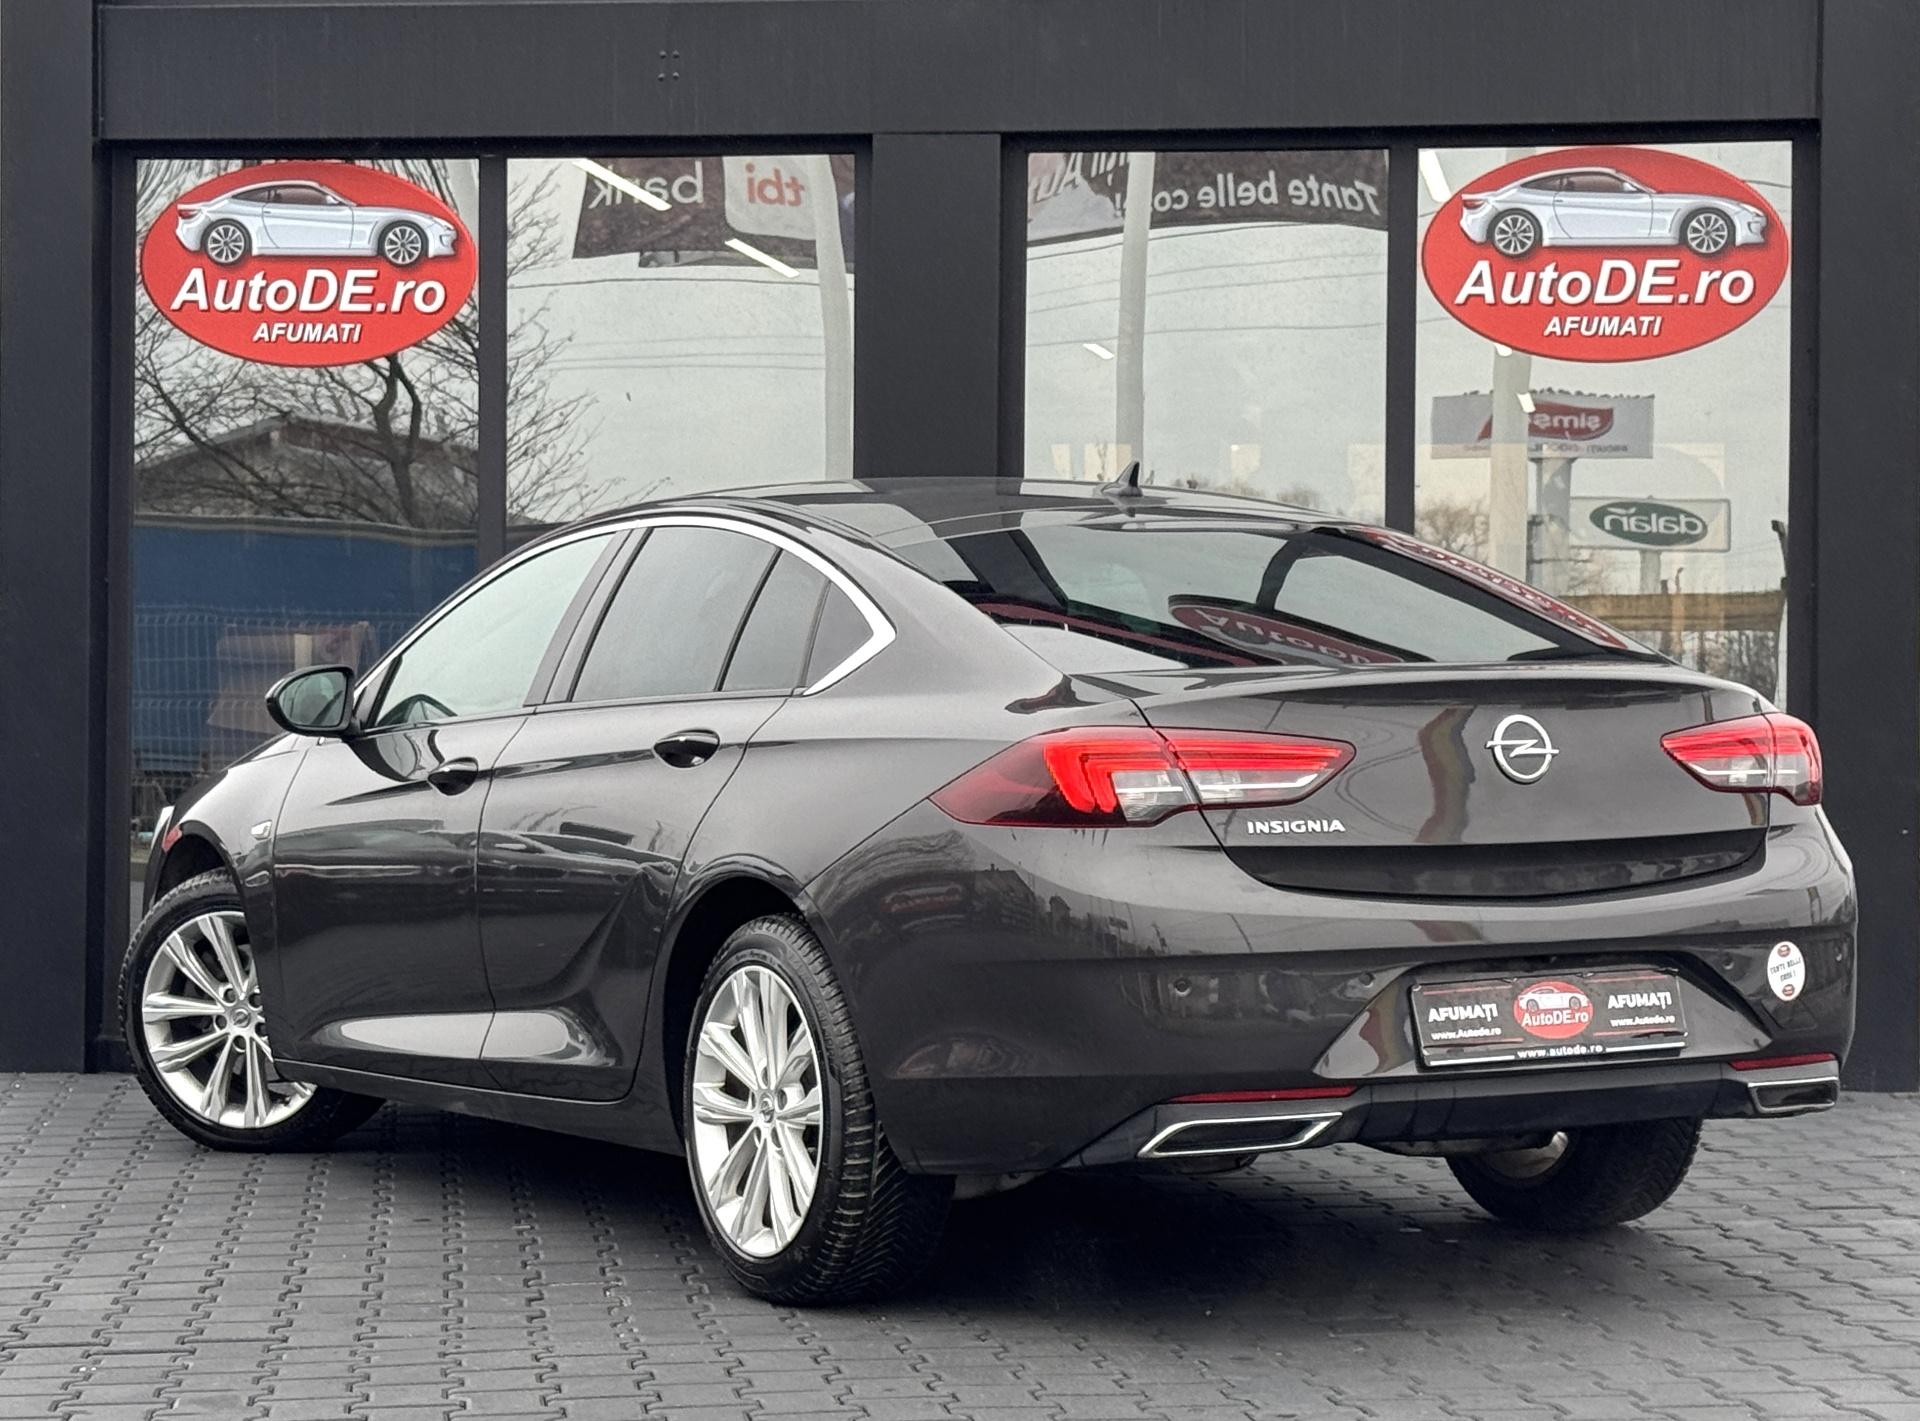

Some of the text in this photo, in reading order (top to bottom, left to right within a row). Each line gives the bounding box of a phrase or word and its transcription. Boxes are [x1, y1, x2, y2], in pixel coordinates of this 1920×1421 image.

[170, 267, 447, 313] AutoDE.ro
[1454, 258, 1756, 305] AutoDE.ro
[252, 322, 362, 344] AFUMATI
[1543, 316, 1662, 337] AFUMATI
[1247, 819, 1346, 834] INSIGNIA
[1521, 1010, 1589, 1027] AutoDE.ro
[1517, 1044, 1604, 1059] www.autode.ro
